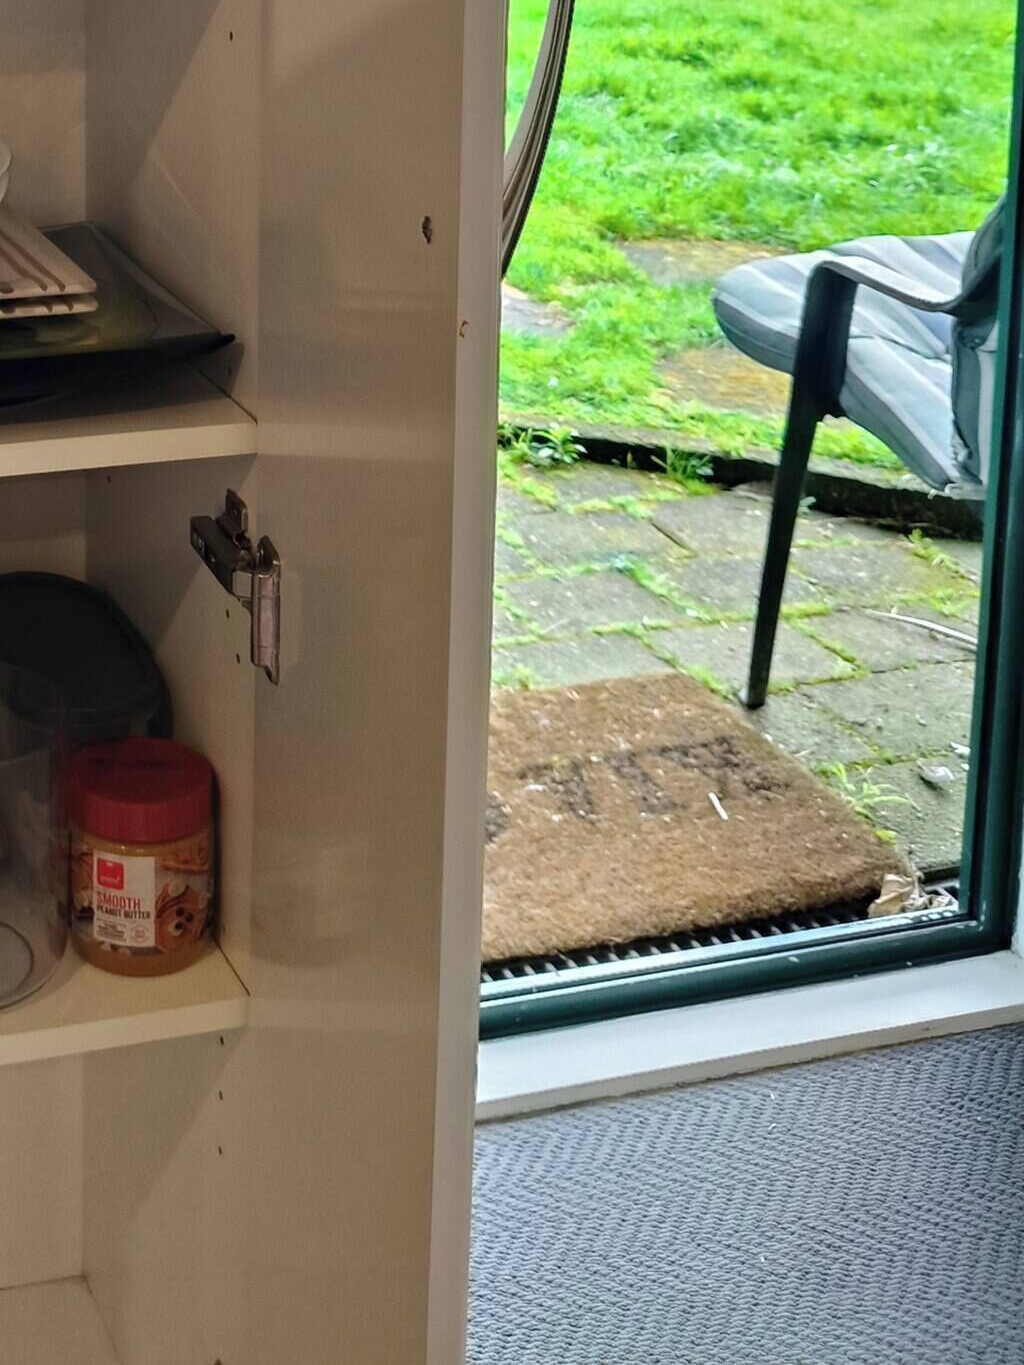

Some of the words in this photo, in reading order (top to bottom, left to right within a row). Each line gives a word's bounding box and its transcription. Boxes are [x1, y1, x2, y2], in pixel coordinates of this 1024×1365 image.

[96, 891, 141, 911] SMOOTH
[96, 904, 122, 917] PEANUT
[123, 909, 151, 920] BUTTER
